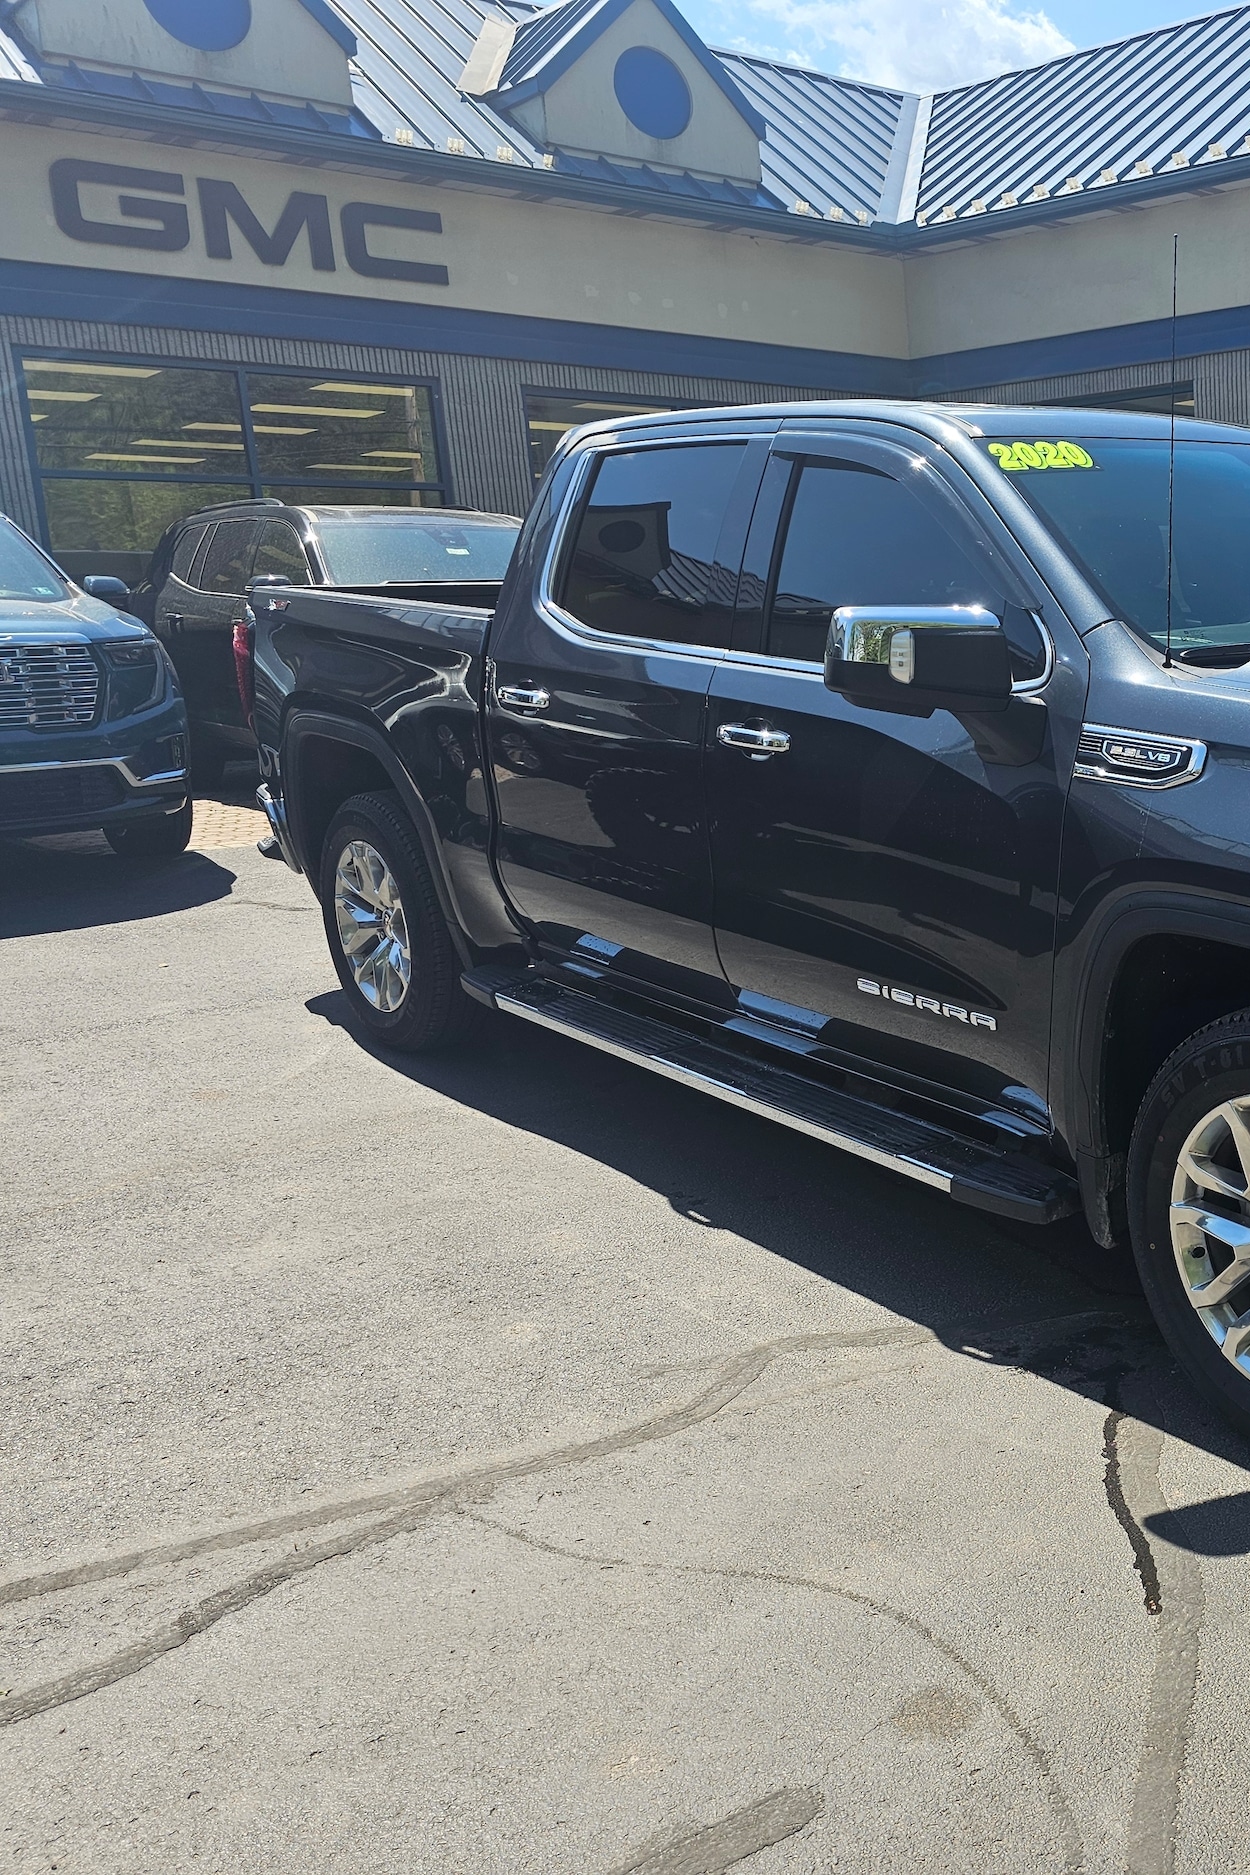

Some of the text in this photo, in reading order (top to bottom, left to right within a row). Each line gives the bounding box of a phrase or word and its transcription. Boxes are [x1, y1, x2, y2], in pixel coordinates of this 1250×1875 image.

[49, 158, 449, 286] GMC
[987, 441, 1094, 471] 2020
[856, 977, 997, 1031] SIERRA
